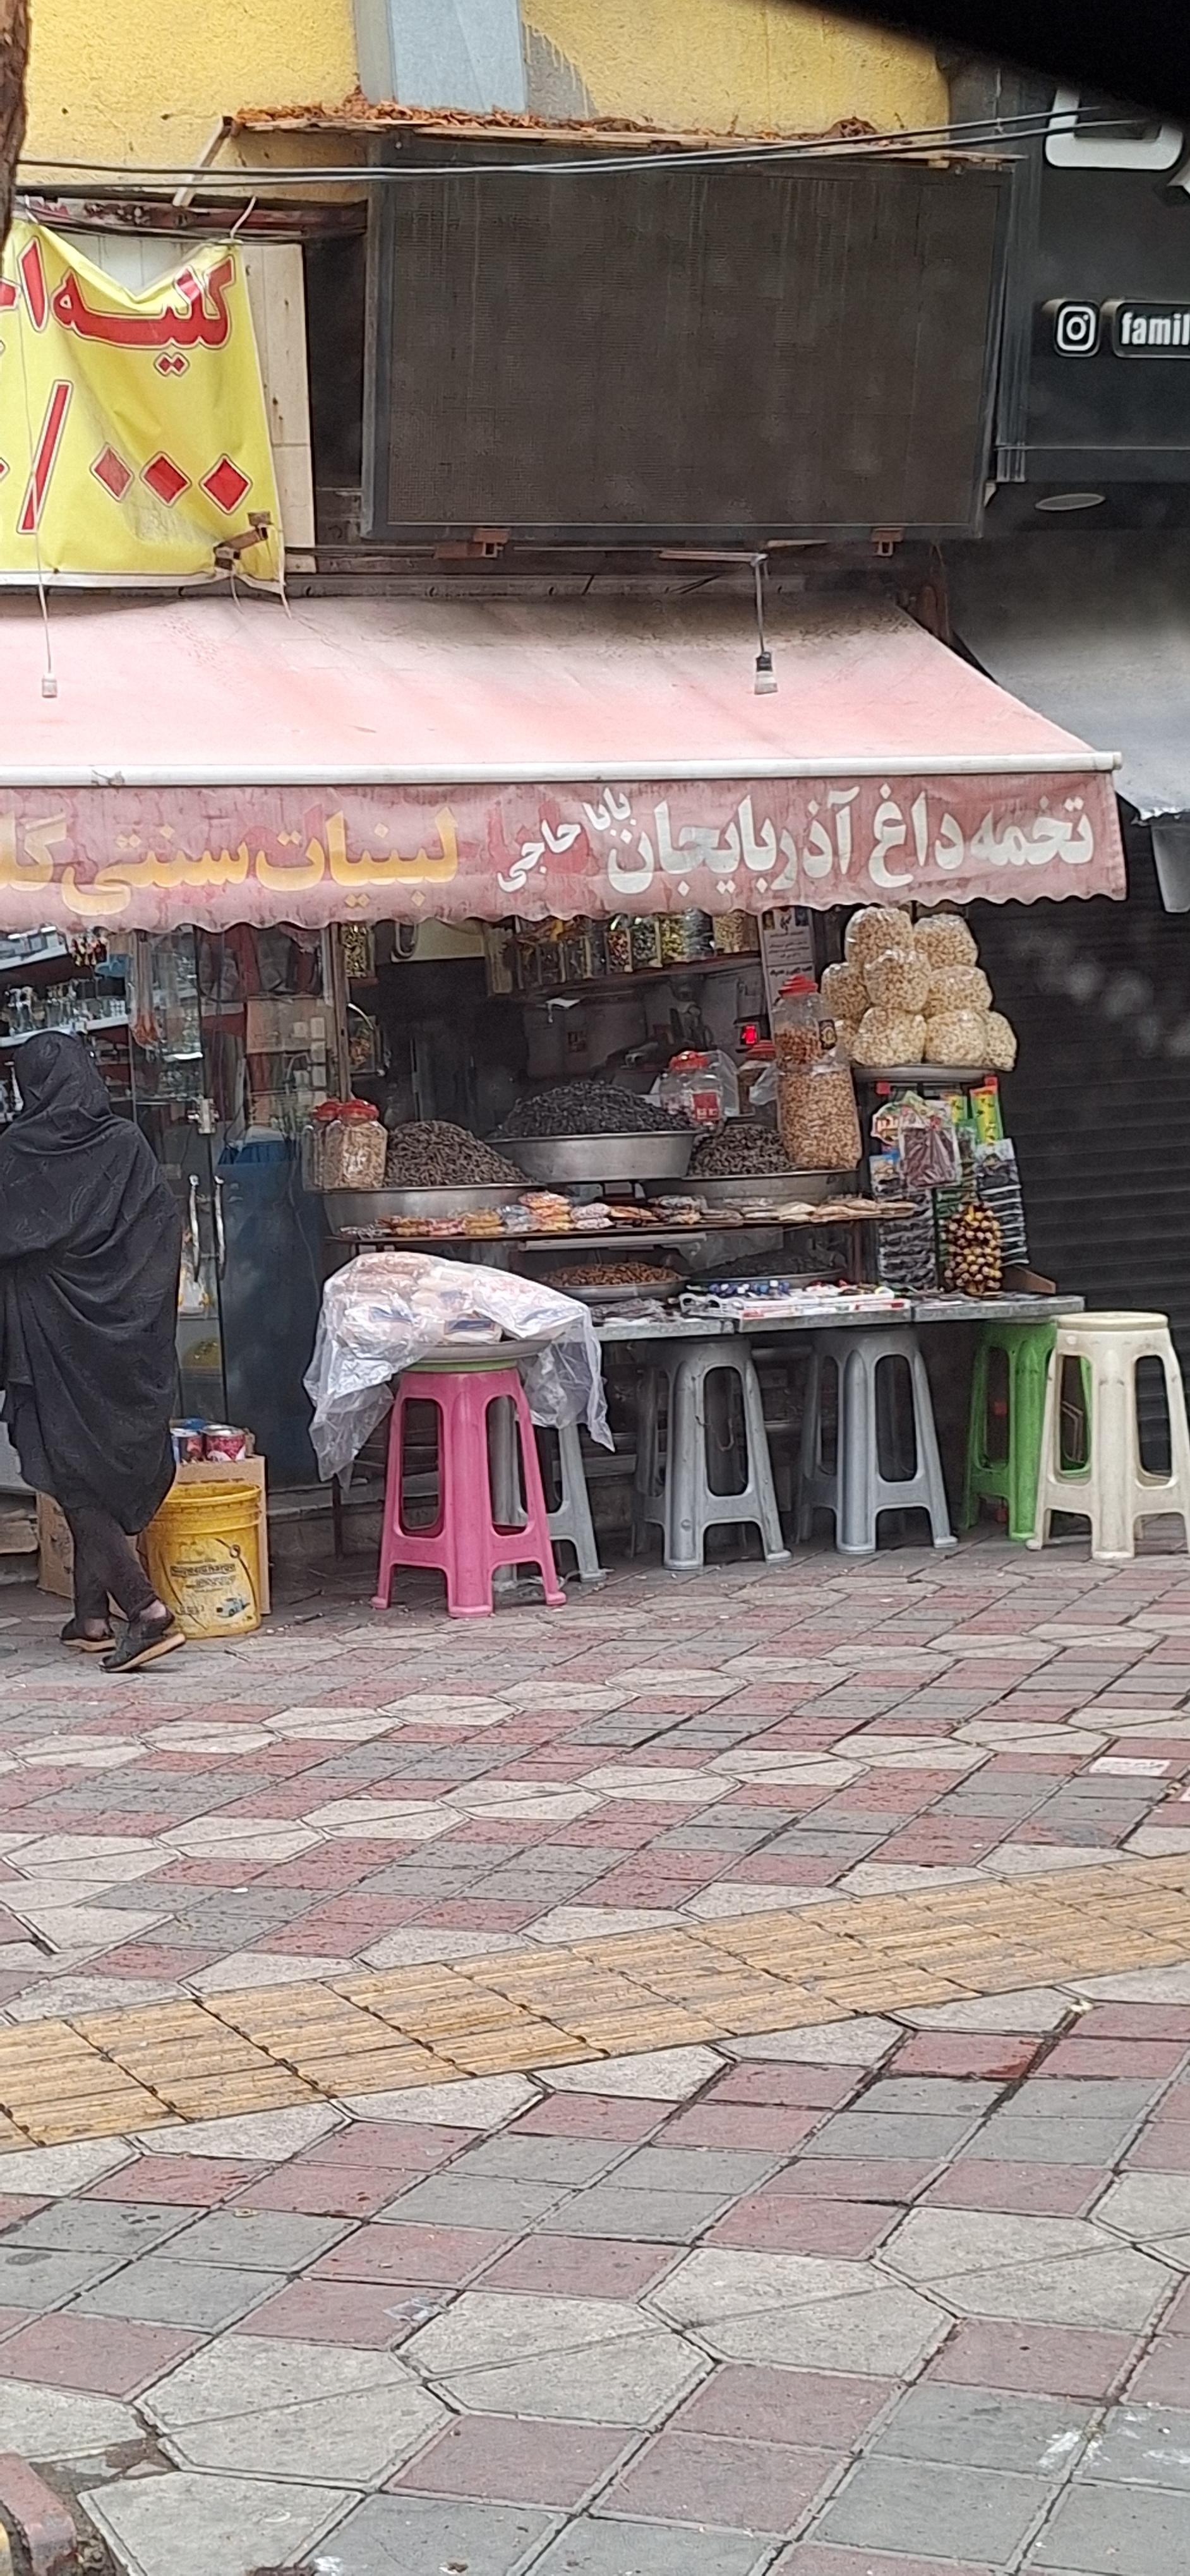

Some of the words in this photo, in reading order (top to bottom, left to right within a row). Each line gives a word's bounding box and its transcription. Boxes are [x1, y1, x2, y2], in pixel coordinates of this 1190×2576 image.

[52, 255, 236, 374] کلیه
[1121, 312, 1190, 346] famil
[255, 806, 459, 907] لبنیات
[498, 818, 582, 893] حاجی
[582, 787, 636, 837] بابا
[607, 786, 860, 897] آذربایجان
[869, 784, 964, 888] داغ
[971, 796, 1094, 866] تخمه
[61, 823, 248, 916] سنتی
